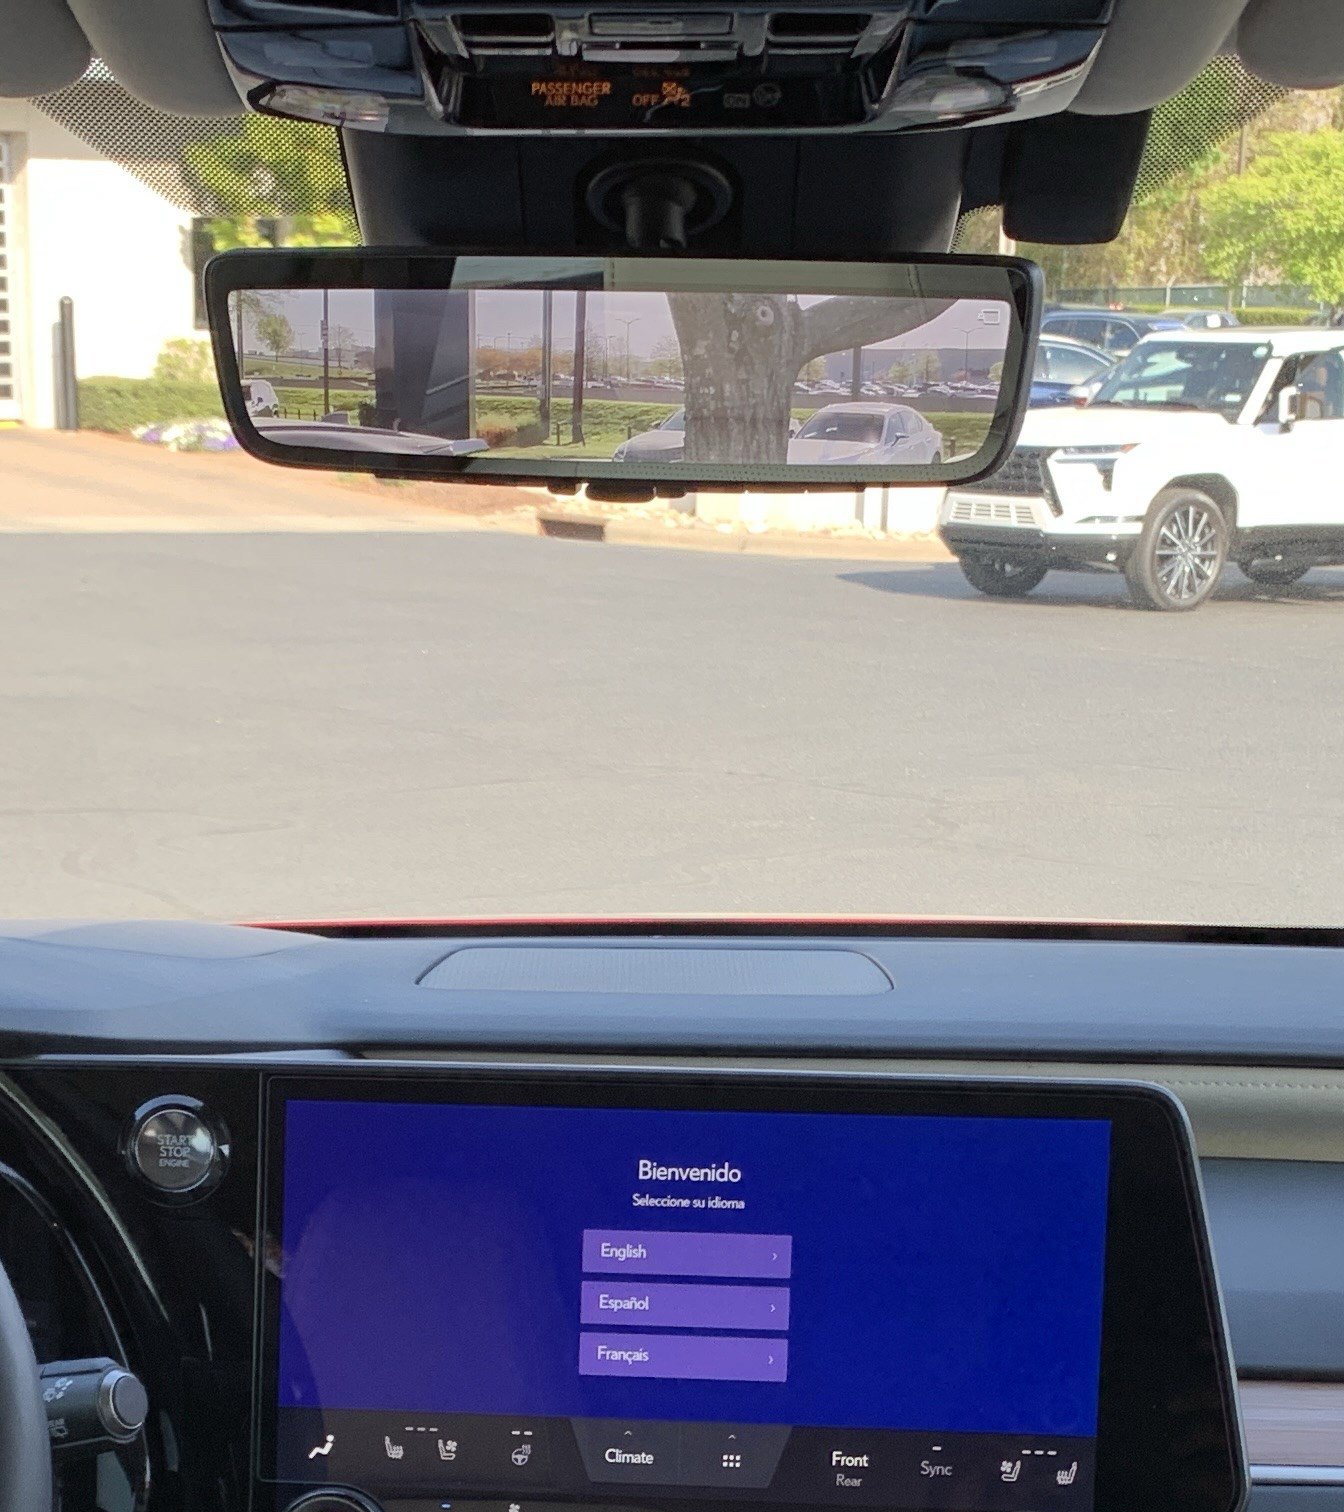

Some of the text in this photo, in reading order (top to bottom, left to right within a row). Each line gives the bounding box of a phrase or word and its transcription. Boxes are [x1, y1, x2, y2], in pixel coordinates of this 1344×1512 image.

[531, 82, 611, 95] PASSENGER
[545, 95, 599, 107] AIR BAG
[631, 94, 659, 107] OFF
[159, 1145, 191, 1158] STOP
[159, 1158, 190, 1167] ENGINE
[638, 1159, 742, 1183] Bienvenido
[632, 1193, 746, 1210] Seleccione su idioma
[600, 1242, 647, 1262] English
[599, 1293, 650, 1312] Español
[597, 1345, 650, 1366] Français
[604, 1447, 953, 1478] Climate Front Sync
[835, 1473, 863, 1488] Rear
